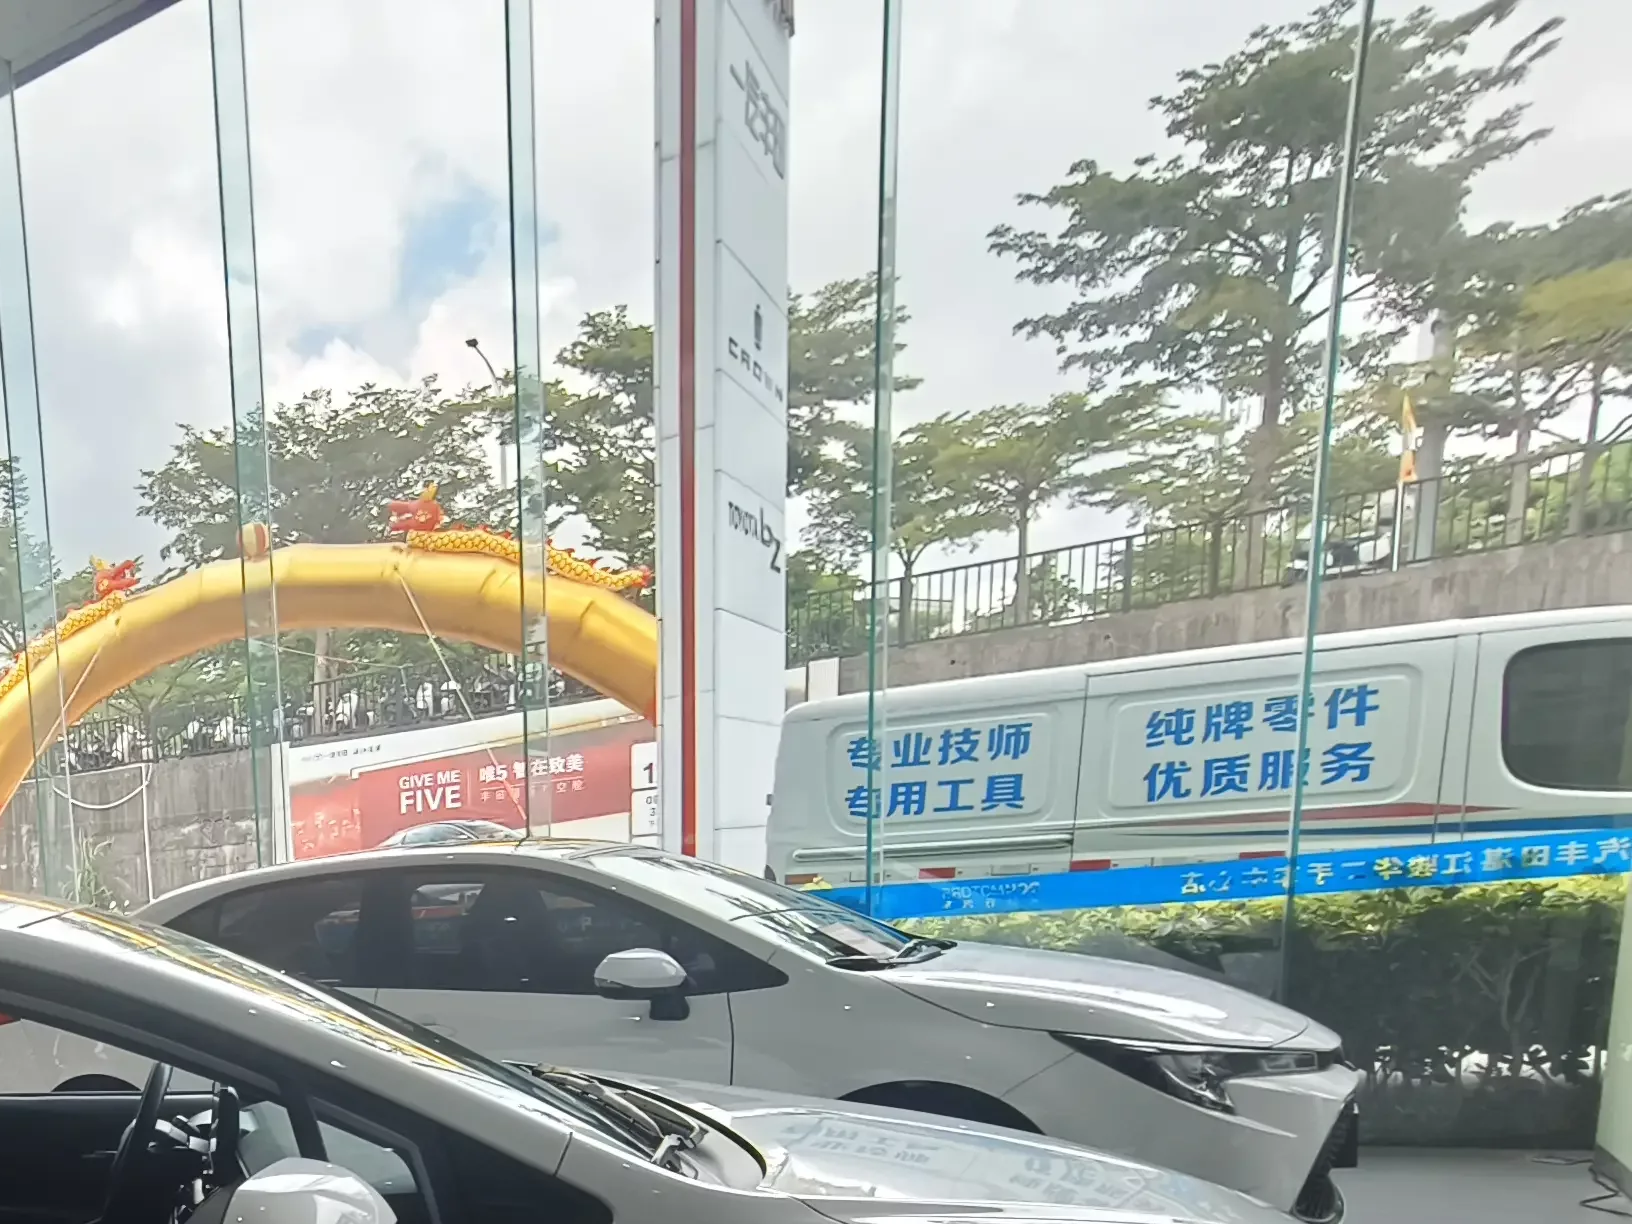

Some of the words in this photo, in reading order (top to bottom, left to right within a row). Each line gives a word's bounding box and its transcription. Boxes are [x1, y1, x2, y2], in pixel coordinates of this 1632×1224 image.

[728, 336, 784, 403] CROWN
[1145, 684, 1381, 749] 纯牌零件
[846, 722, 1034, 773] 专业技师
[1143, 742, 1376, 803] 优质服务
[398, 773, 434, 791] GIVE
[436, 769, 461, 785] ME
[399, 784, 462, 816] FIVE
[844, 773, 1026, 820] 专用工具
